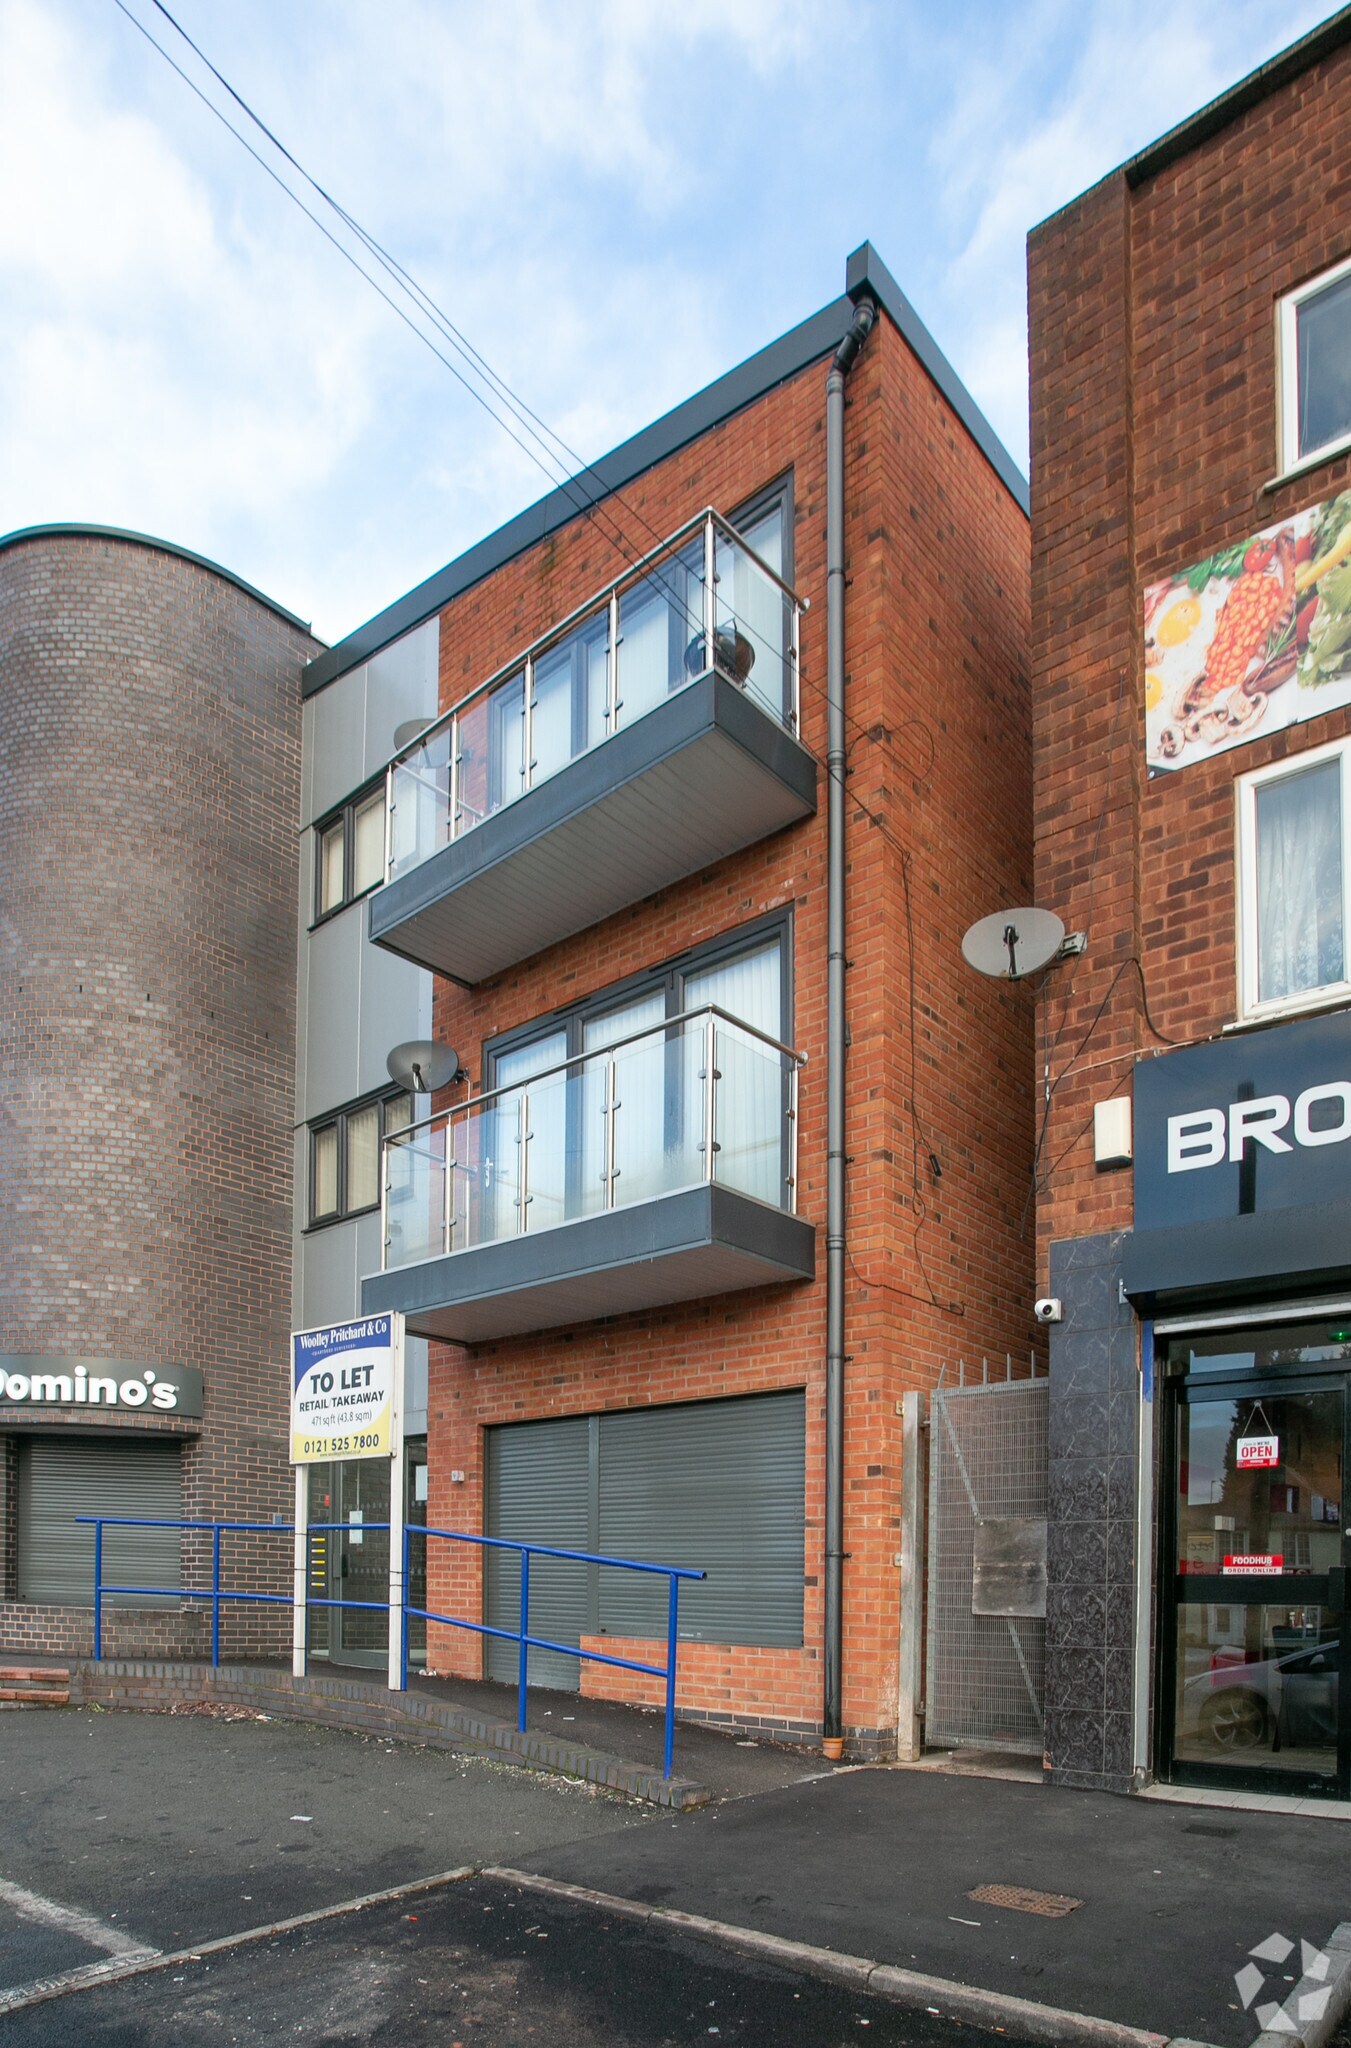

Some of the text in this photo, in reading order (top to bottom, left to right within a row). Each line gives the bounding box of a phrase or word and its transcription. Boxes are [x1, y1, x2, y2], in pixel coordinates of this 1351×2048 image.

[1167, 1081, 1351, 1174] BRO
[300, 1319, 387, 1349] Woolley Pritchard & Co
[310, 1365, 374, 1394] TO LET
[299, 1390, 385, 1412] RETAIL TAKEAWAY
[304, 1433, 379, 1453] 0121 525 7800
[1241, 1445, 1272, 1458] OPEN
[1232, 1556, 1272, 1565] FOODHUB
